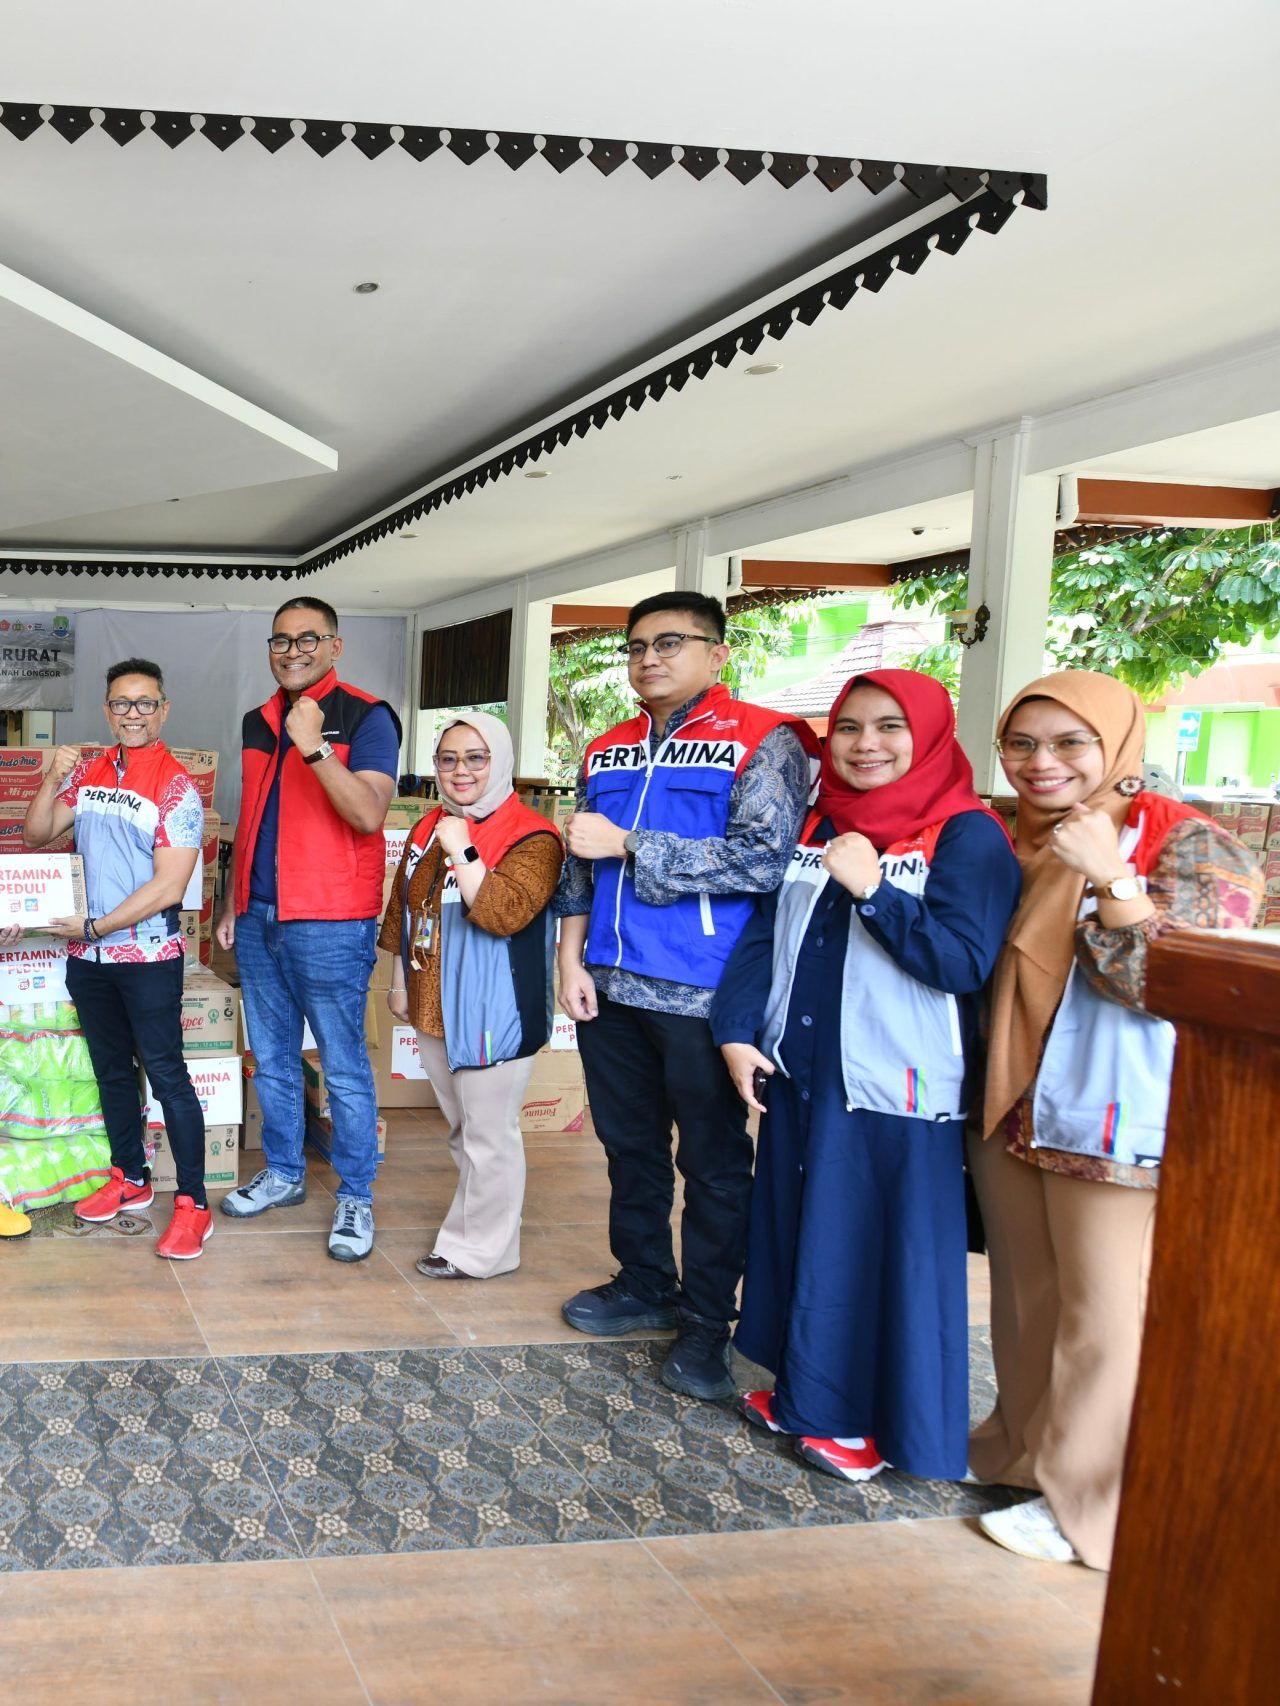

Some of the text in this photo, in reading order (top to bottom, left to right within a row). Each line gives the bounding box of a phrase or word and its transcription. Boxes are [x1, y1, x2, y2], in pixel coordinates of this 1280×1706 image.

[22, 790, 37, 798] gor
[188, 1072, 231, 1085] AMINA
[196, 1086, 215, 1096] ULI
